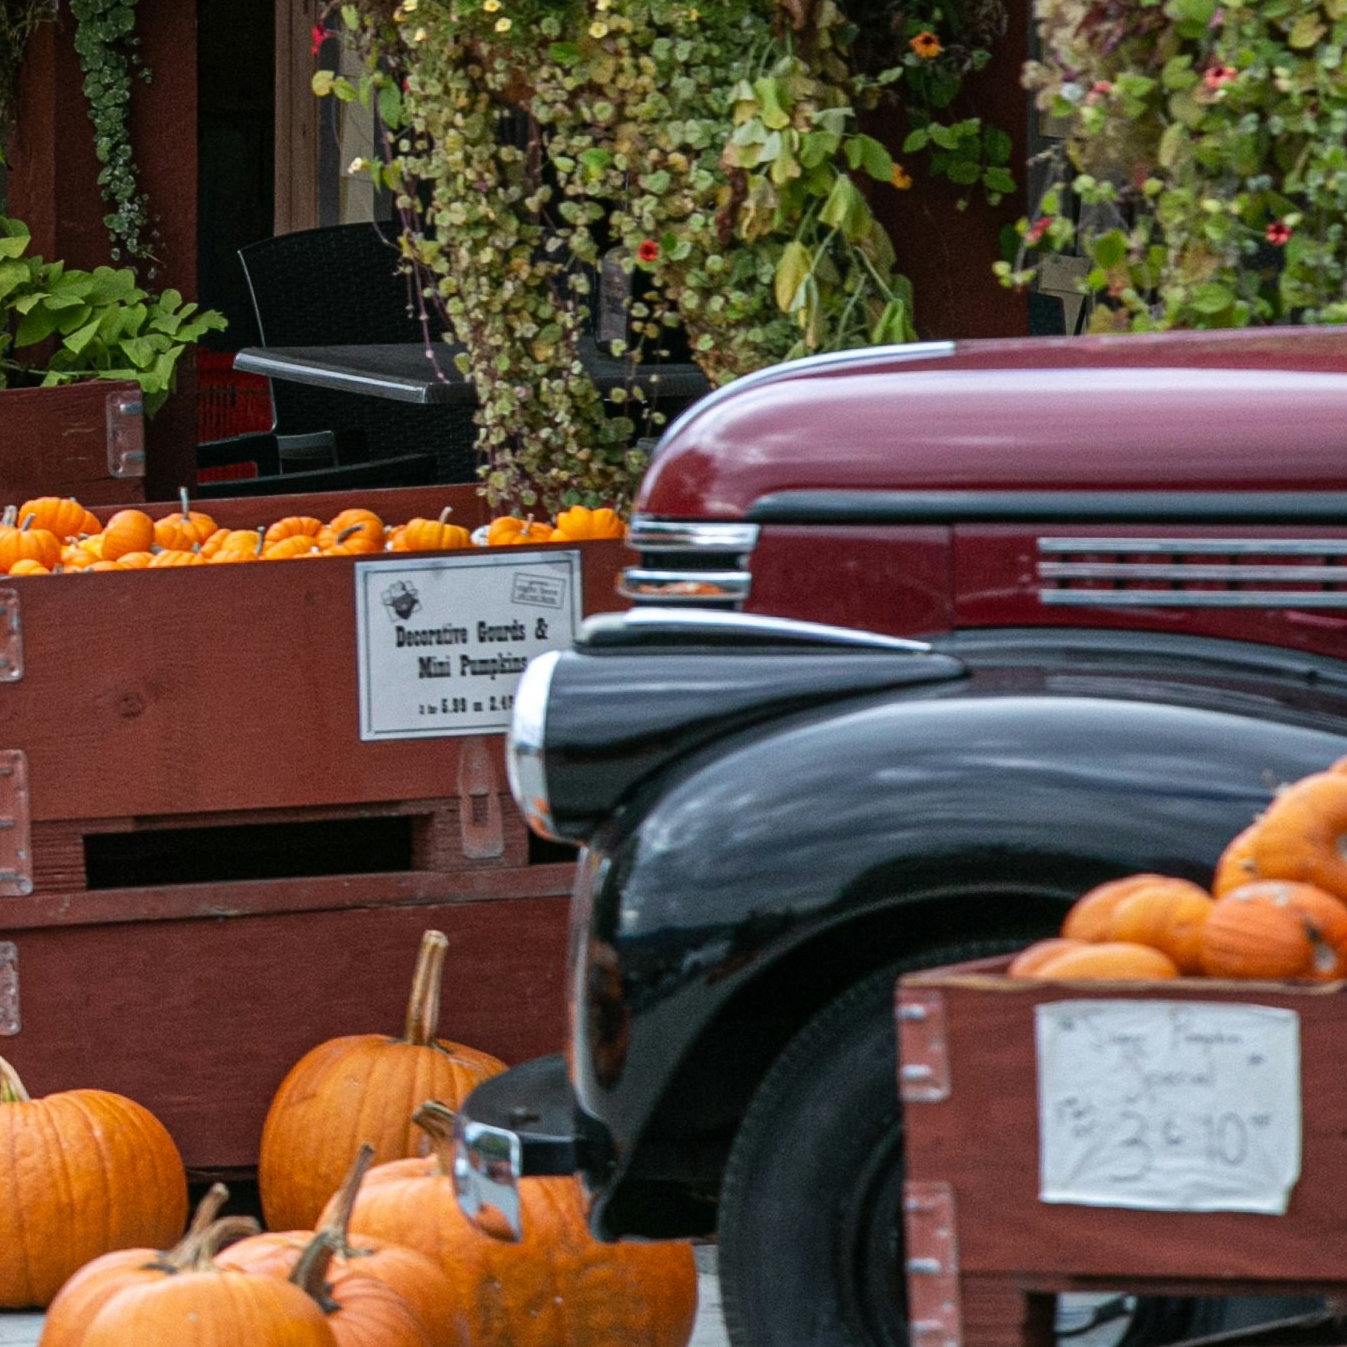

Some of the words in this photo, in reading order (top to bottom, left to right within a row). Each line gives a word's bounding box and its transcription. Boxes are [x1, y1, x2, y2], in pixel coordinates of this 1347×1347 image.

[396, 624, 467, 647] Decorative
[478, 619, 525, 643] Gourds
[535, 618, 548, 639] &
[419, 656, 451, 678] Mini
[460, 653, 527, 680] Pumpkins
